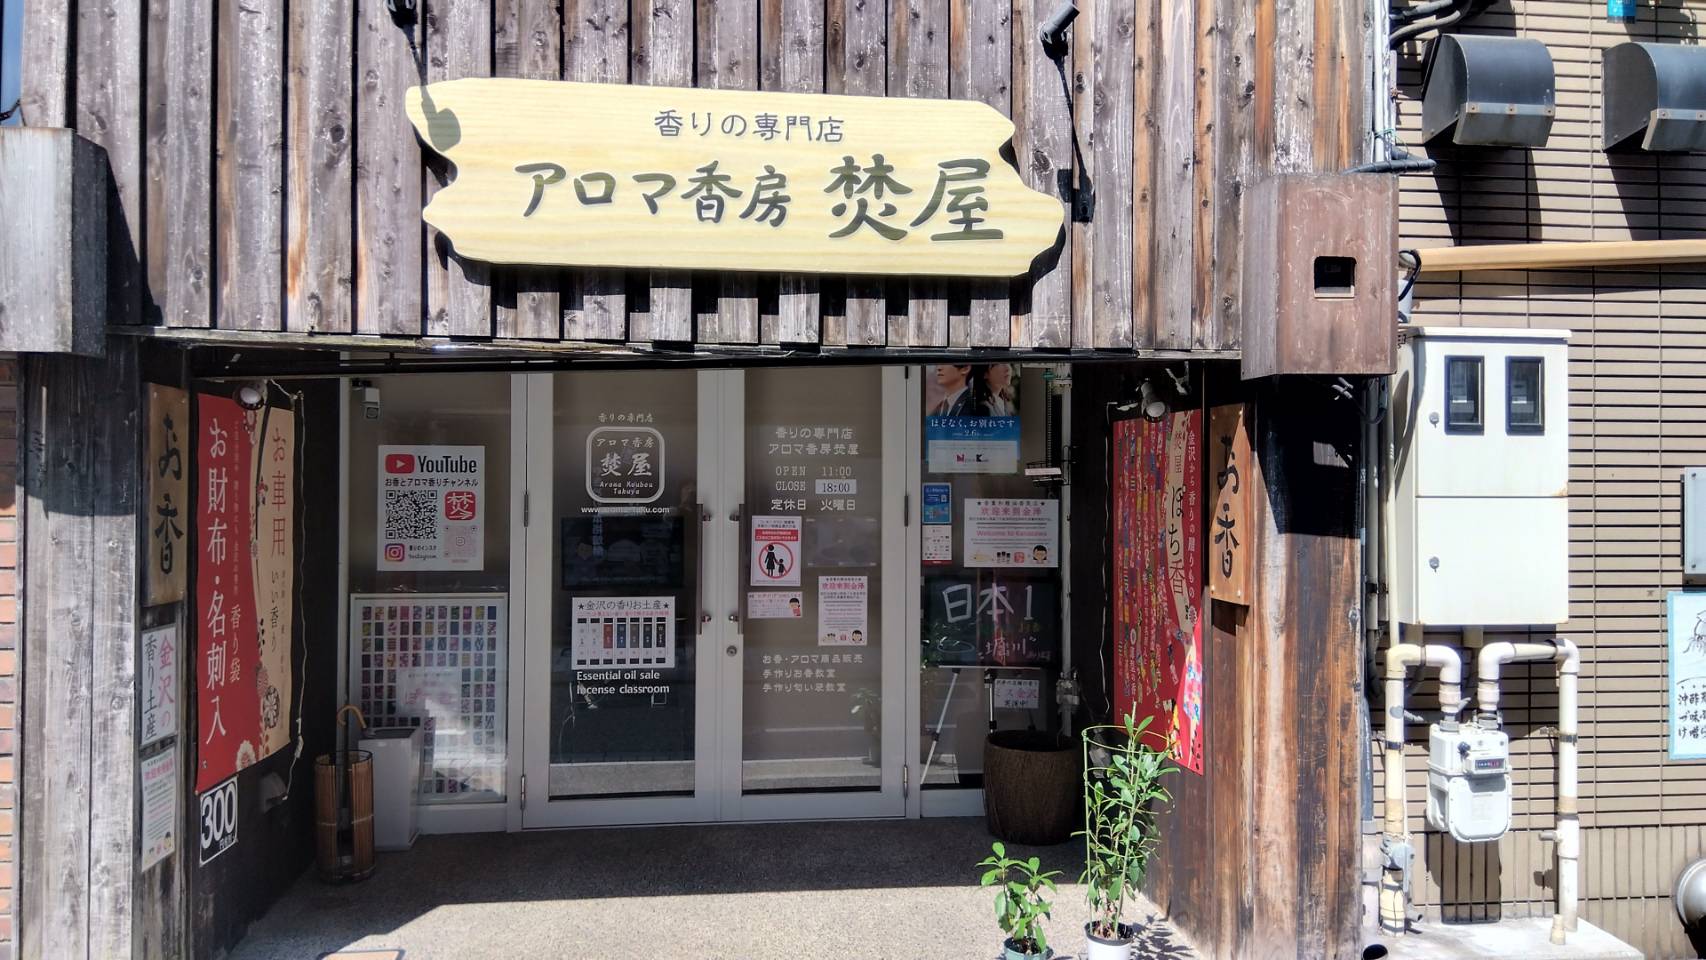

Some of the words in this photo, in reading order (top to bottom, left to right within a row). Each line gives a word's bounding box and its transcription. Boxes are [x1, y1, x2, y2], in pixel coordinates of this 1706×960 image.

[653, 108, 845, 143] 香りの専門店
[515, 159, 792, 227] アロマ香房
[823, 153, 1005, 242] 焚屋
[598, 412, 654, 423] 香りの専門店
[931, 418, 1015, 428] ほどなく、お別れです
[596, 436, 654, 448] アロマ香房
[775, 427, 854, 440] 香りの専門店
[418, 455, 477, 473] YouTube
[600, 451, 652, 477] 焚屋
[775, 466, 806, 476] OPEN
[822, 466, 852, 476] 11:00
[153, 414, 184, 575] お香
[271, 427, 287, 557] お車用
[775, 480, 806, 491] CLOSE
[822, 482, 850, 493] 18:00
[771, 498, 806, 510] 定休日
[820, 498, 856, 511] 火曜日
[1214, 434, 1240, 579] お香
[205, 417, 228, 745] お財布・名刺入
[586, 600, 662, 611] 金沢の香りお土産
[229, 603, 242, 682] 香り袋
[158, 634, 175, 728] 金沢の
[576, 670, 621, 680] Essential
[623, 670, 637, 680] oil
[639, 670, 661, 680] sale
[143, 634, 158, 743] 香り土産
[619, 683, 670, 694] classroom
[200, 782, 236, 850] 300
